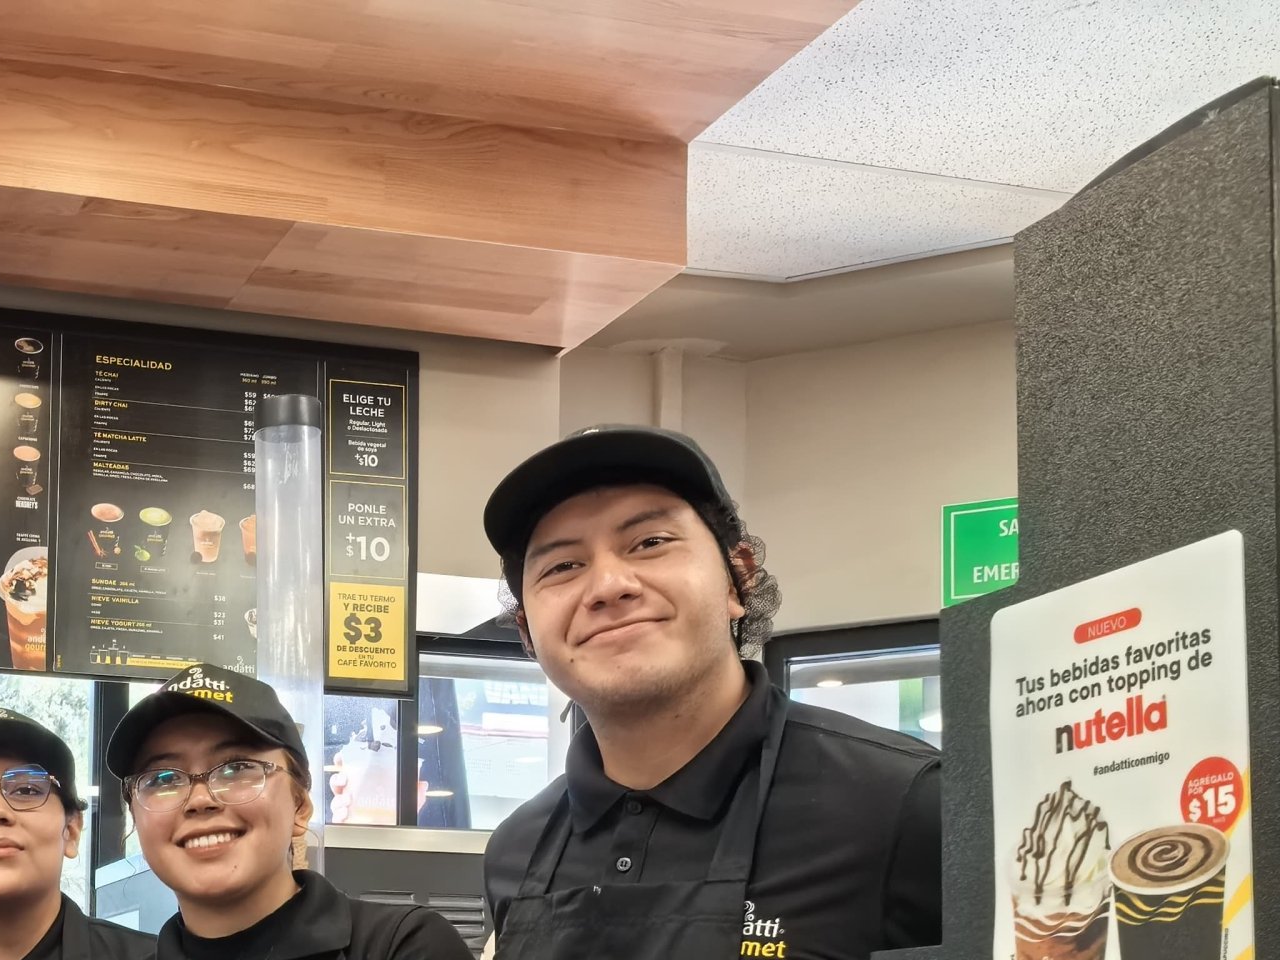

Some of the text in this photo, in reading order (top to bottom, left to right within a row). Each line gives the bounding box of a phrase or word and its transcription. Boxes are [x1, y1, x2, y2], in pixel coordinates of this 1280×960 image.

[95, 354, 172, 371] ESPECIALIDAD
[342, 393, 391, 406] ELIGE TU
[349, 406, 385, 418] LECHE
[347, 502, 387, 515] PONLE
[338, 515, 396, 528] UN EXTRA
[999, 518, 1019, 537] SA
[973, 562, 1020, 584] EMER
[337, 592, 396, 603] TRAE TU TERMO
[343, 602, 390, 614] Y RECIBE
[342, 612, 383, 645] $3
[1087, 616, 1127, 638] NUEVO
[336, 644, 396, 655] DE DESCUENTO
[337, 656, 397, 669] CAFÉ FAVORITO
[1015, 627, 1212, 697] Tus bebidas favoritas
[1015, 649, 1213, 718] ahora con topping de
[1055, 694, 1168, 754] nutella
[1092, 751, 1170, 776] #andatticonmigo
[1187, 771, 1235, 788] AGRÉGALO
[1187, 785, 1203, 795] POR
[1188, 783, 1236, 822] $15
